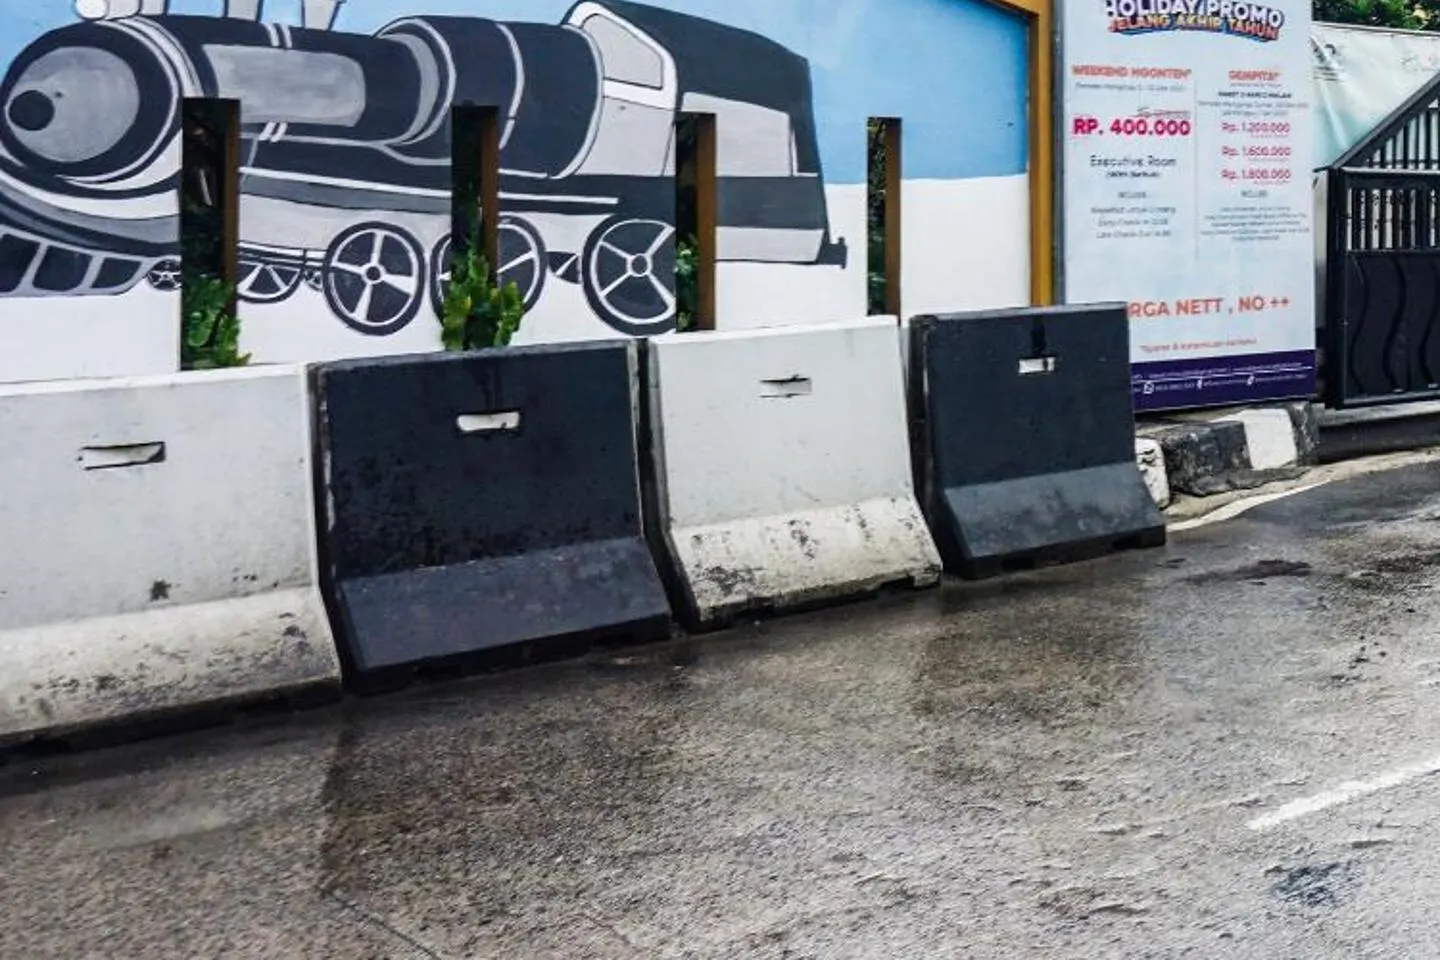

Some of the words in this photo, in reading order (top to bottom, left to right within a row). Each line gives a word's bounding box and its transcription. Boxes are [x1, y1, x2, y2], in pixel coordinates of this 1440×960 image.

[1226, 18, 1280, 41] TAHUN
[1073, 117, 1104, 136] RP.
[1109, 117, 1192, 137] 400.000
[1127, 301, 1170, 318] RGA
[1176, 298, 1223, 316] NETT
[1238, 296, 1265, 313] NO
